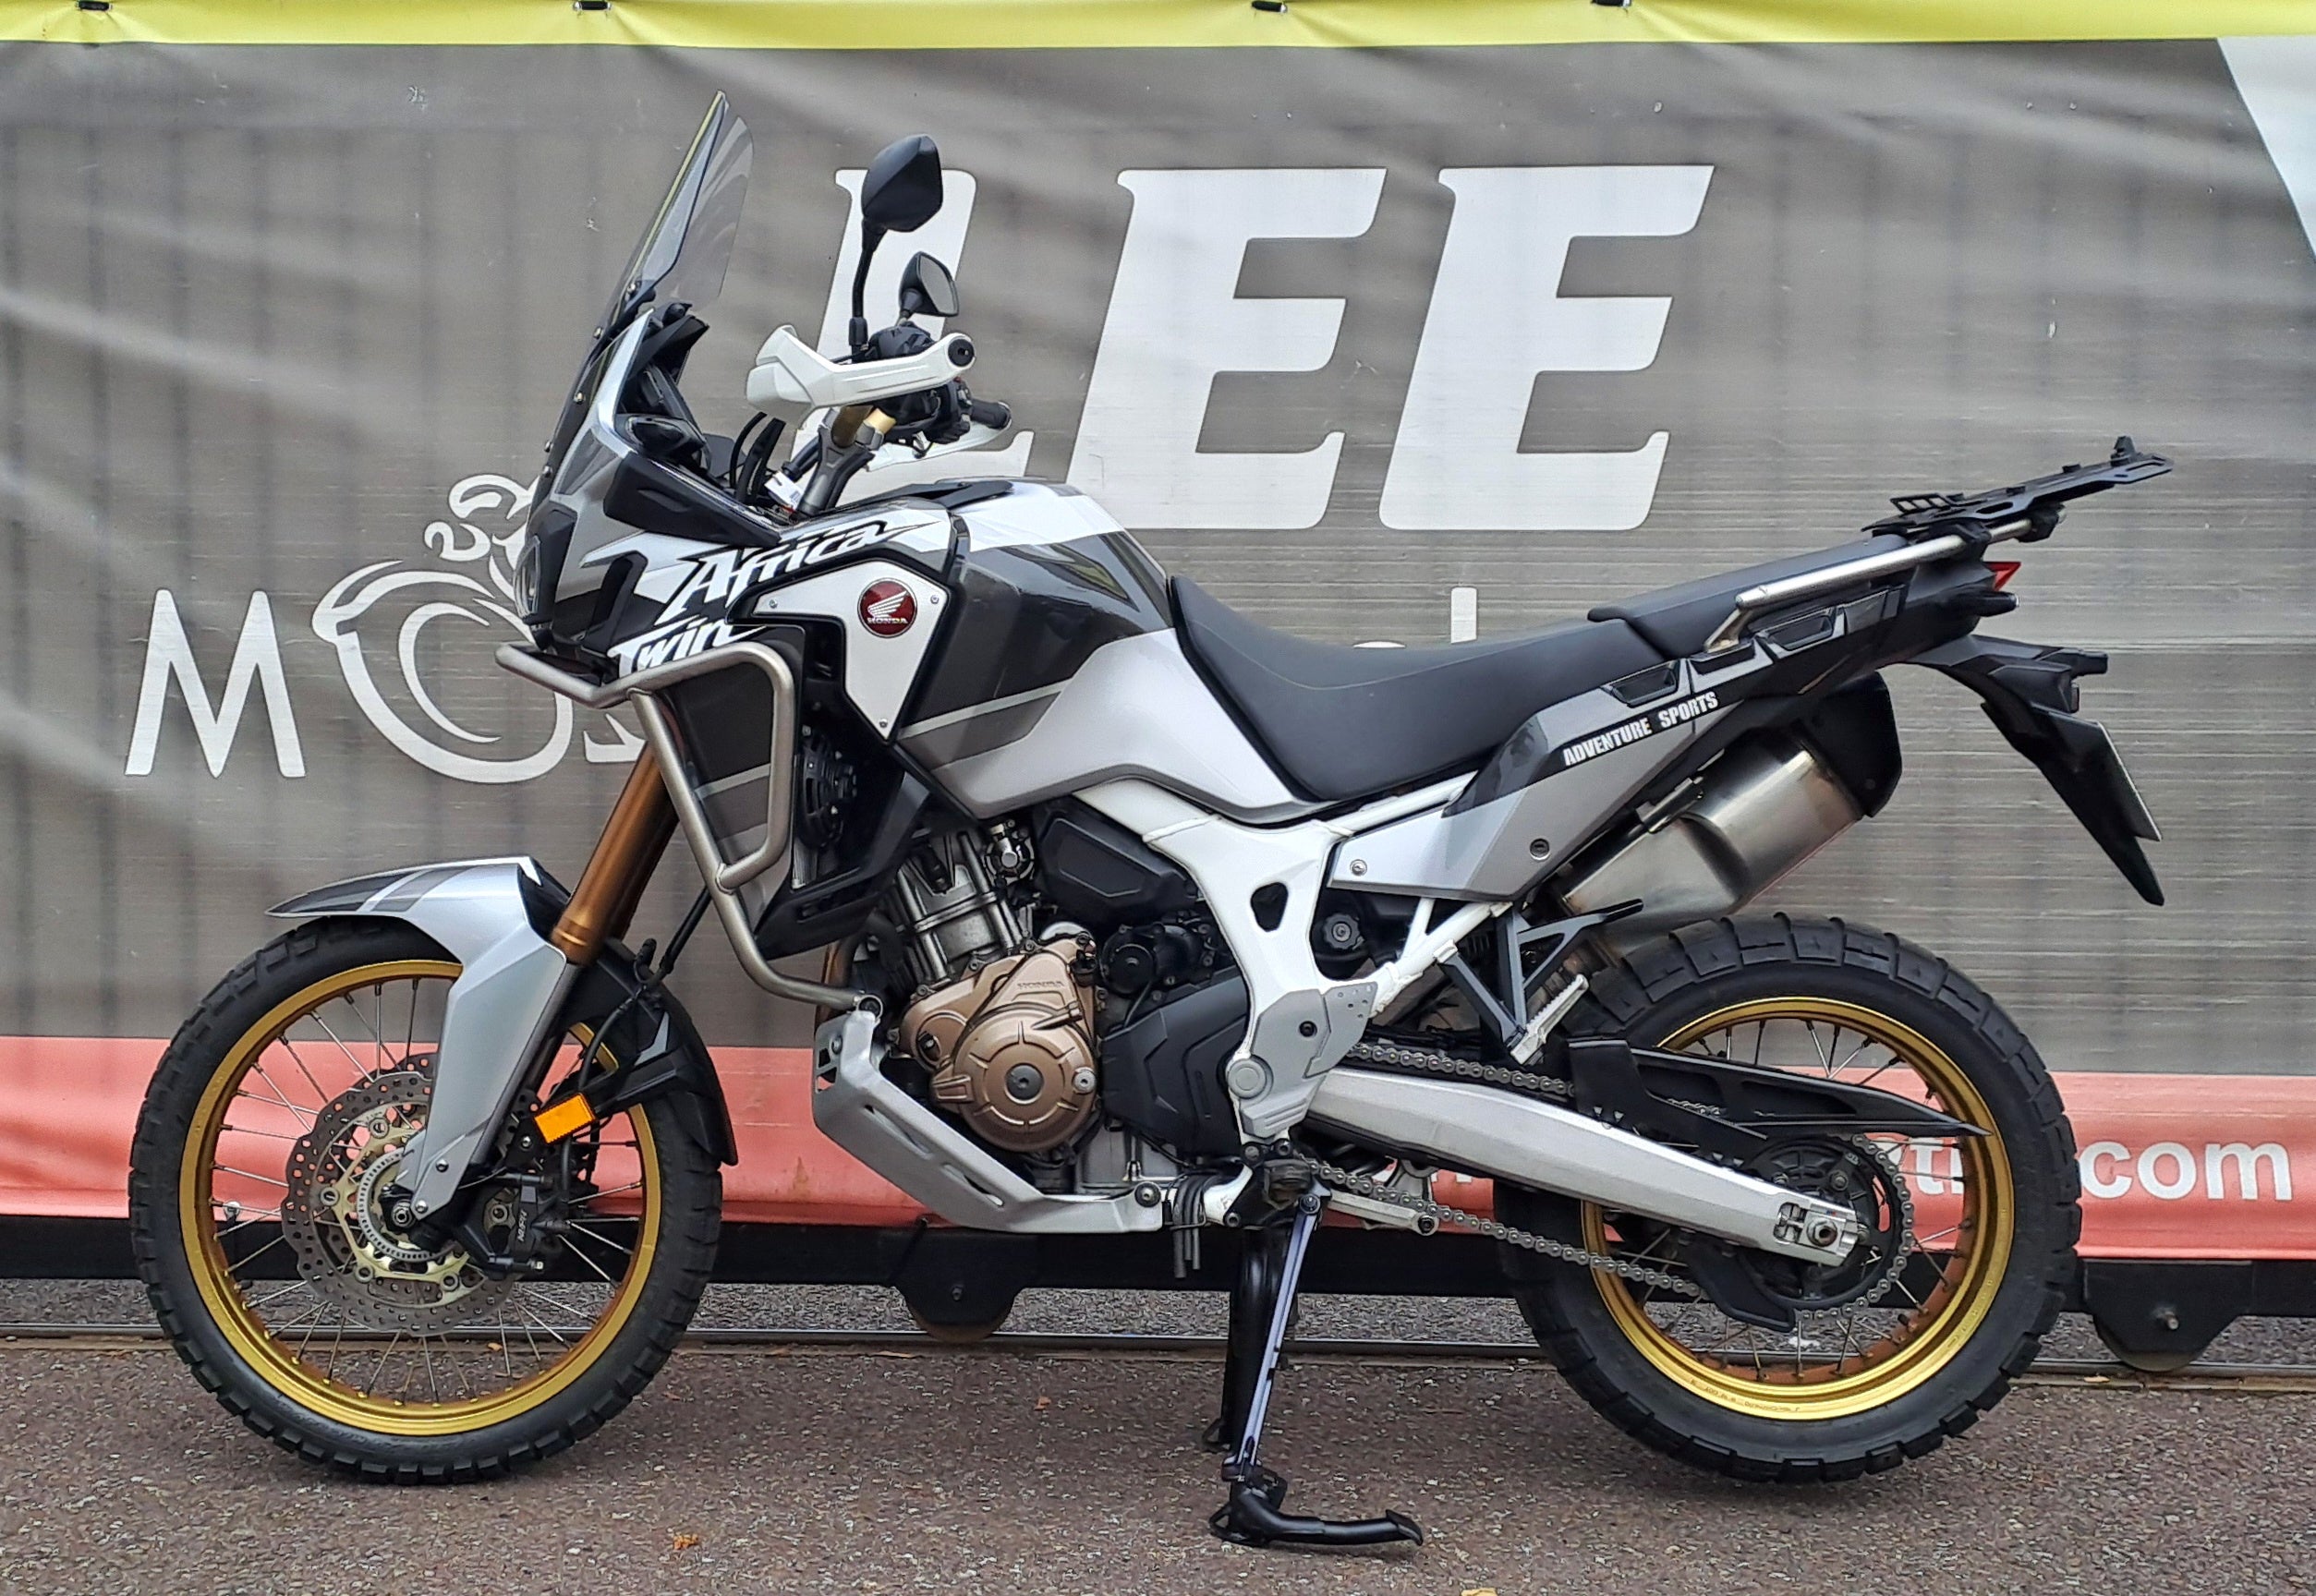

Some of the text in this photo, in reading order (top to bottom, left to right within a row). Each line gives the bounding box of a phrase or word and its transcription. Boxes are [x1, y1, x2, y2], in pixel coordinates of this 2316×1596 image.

[789, 163, 1715, 530] LEE
[653, 519, 940, 626] Africa
[607, 614, 767, 680] Twin
[1562, 691, 1718, 767] ADVENTURE SPORTS
